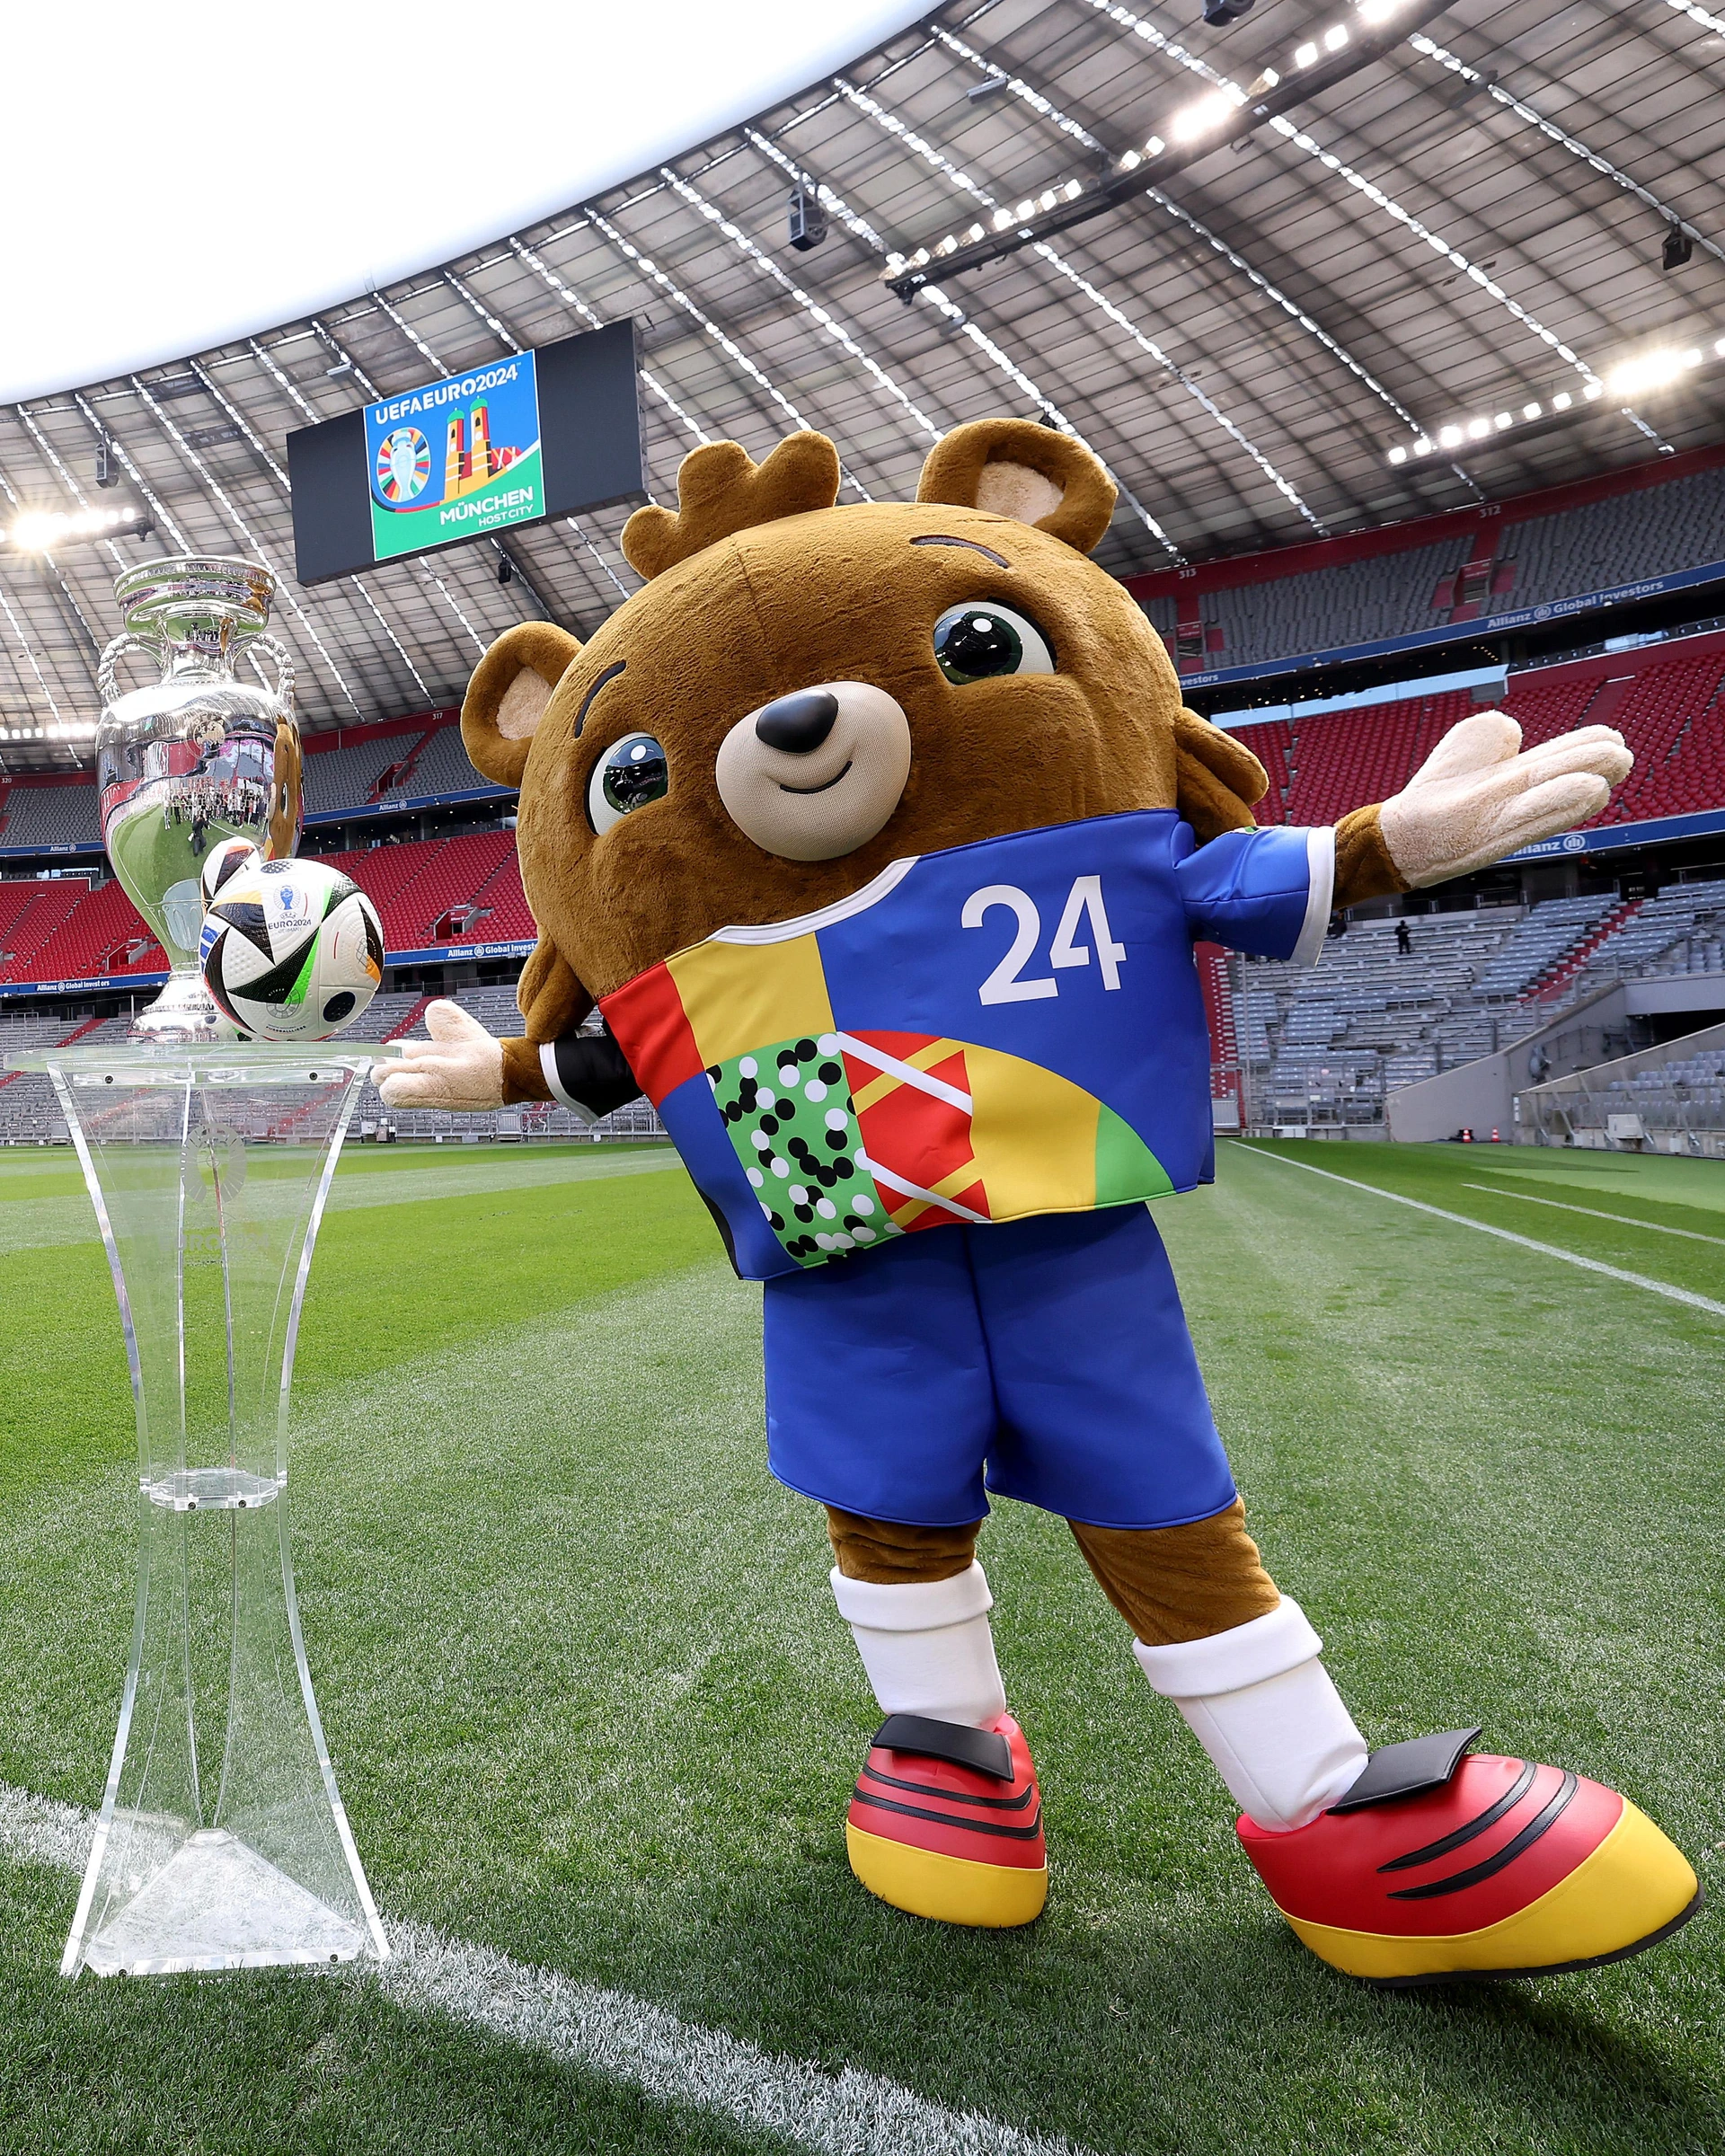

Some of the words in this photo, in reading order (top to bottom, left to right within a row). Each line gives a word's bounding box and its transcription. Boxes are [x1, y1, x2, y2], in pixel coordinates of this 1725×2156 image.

[439, 485, 534, 526] MÜNCHEN
[1479, 504, 1501, 518] 312
[478, 510, 508, 527] HOST
[508, 504, 534, 518] CITY
[1178, 568, 1197, 579] 313
[1487, 612, 1532, 629] Allianz
[1552, 595, 1597, 614] Global
[1599, 581, 1664, 603] Investors
[1181, 674, 1219, 686] vestors
[432, 712, 443, 720] 317
[378, 803, 399, 812] Allianz
[268, 918, 312, 931] EURO2024
[960, 874, 1128, 1006] 24
[447, 949, 473, 958] Allianz
[485, 945, 510, 954] Global
[511, 941, 537, 952] Invest
[37, 984, 58, 992] Allianz
[66, 981, 84, 989] Global
